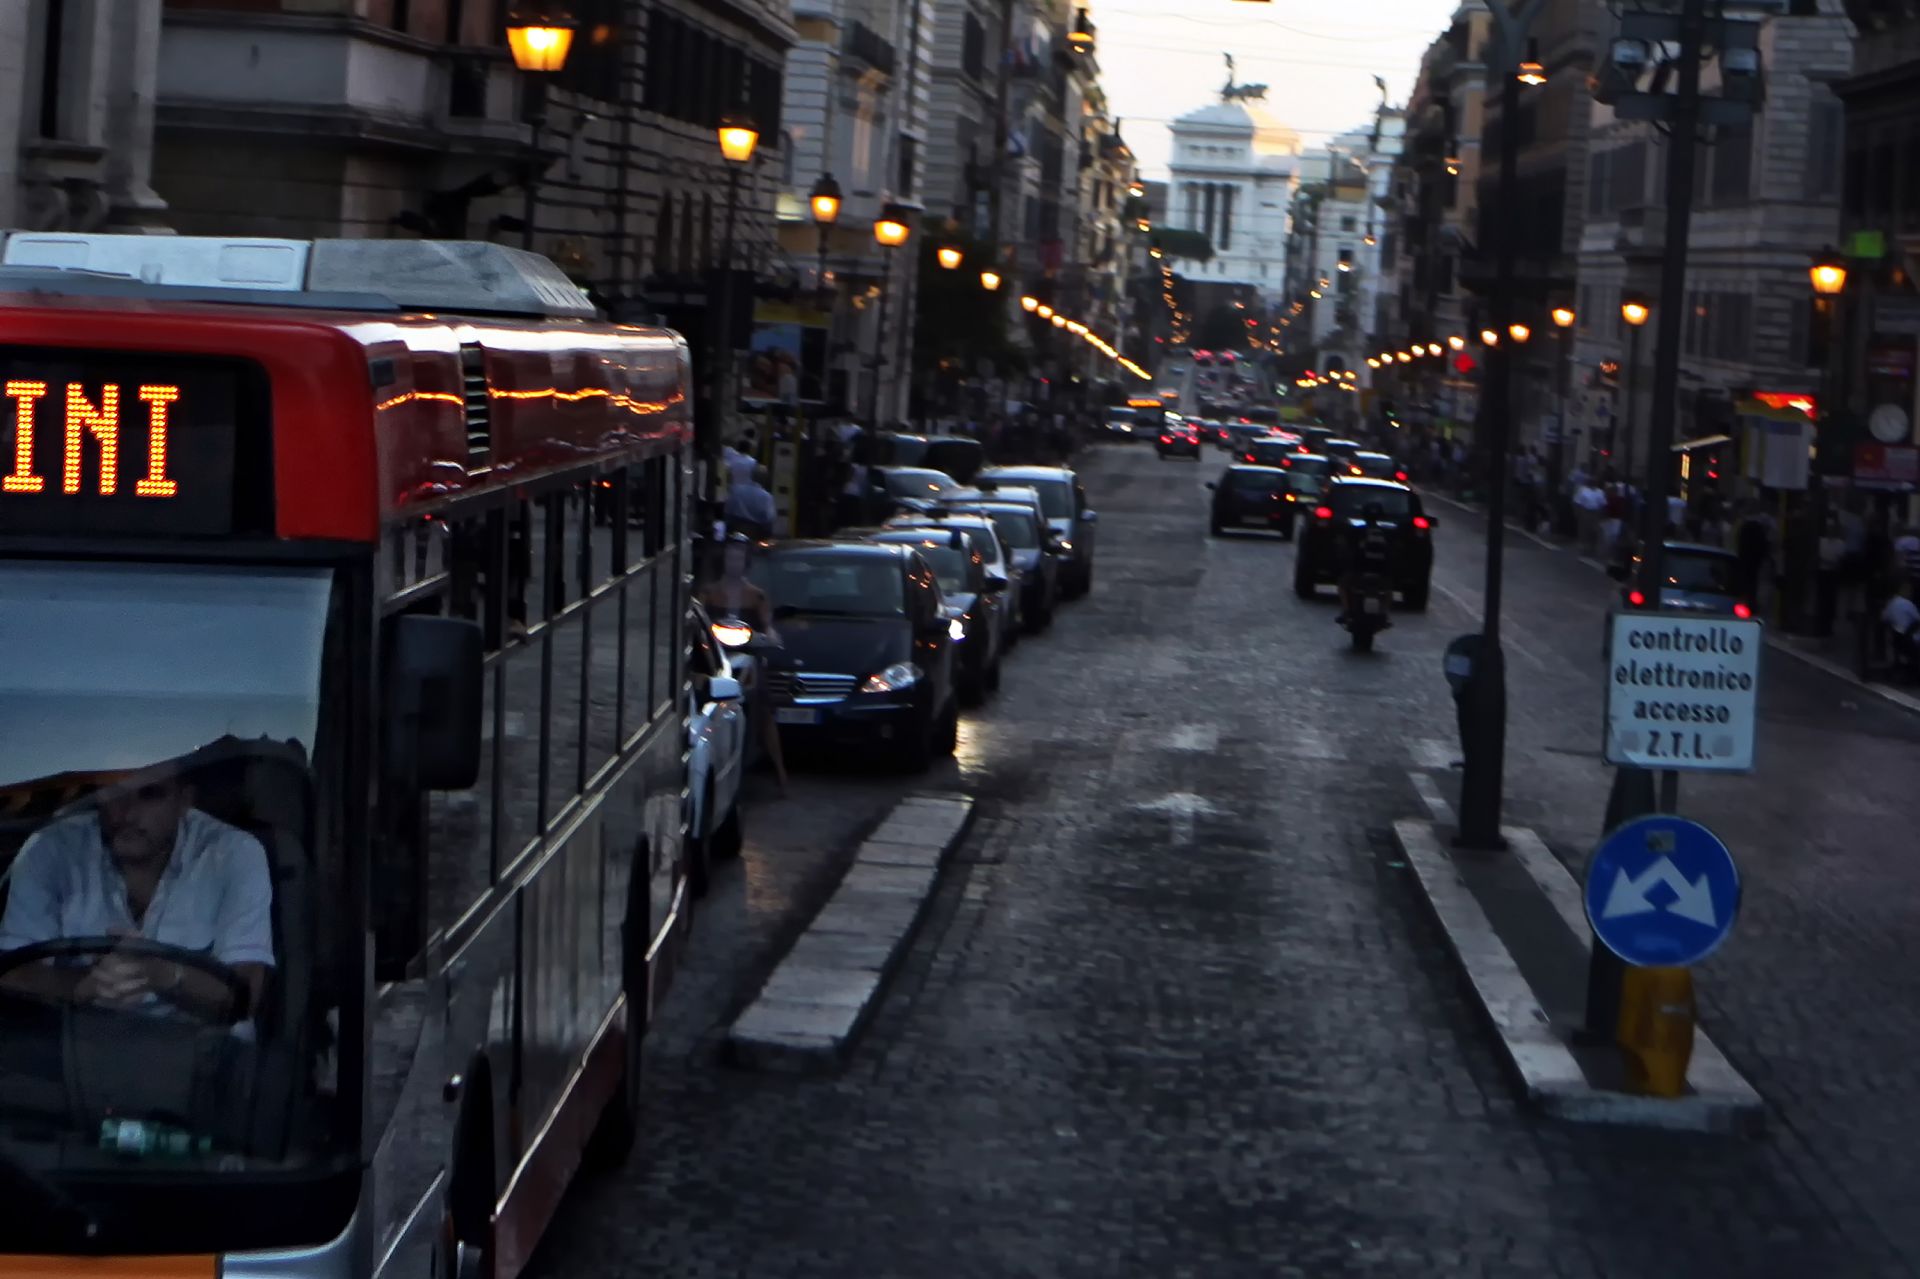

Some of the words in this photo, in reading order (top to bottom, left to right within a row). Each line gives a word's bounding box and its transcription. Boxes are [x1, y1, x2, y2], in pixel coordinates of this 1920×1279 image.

[2, 380, 180, 496] INI
[1628, 626, 1744, 655] controllo
[1615, 659, 1753, 691] elettronico
[1633, 700, 1730, 724] accesso
[1646, 729, 1712, 760] Z.T.L.
